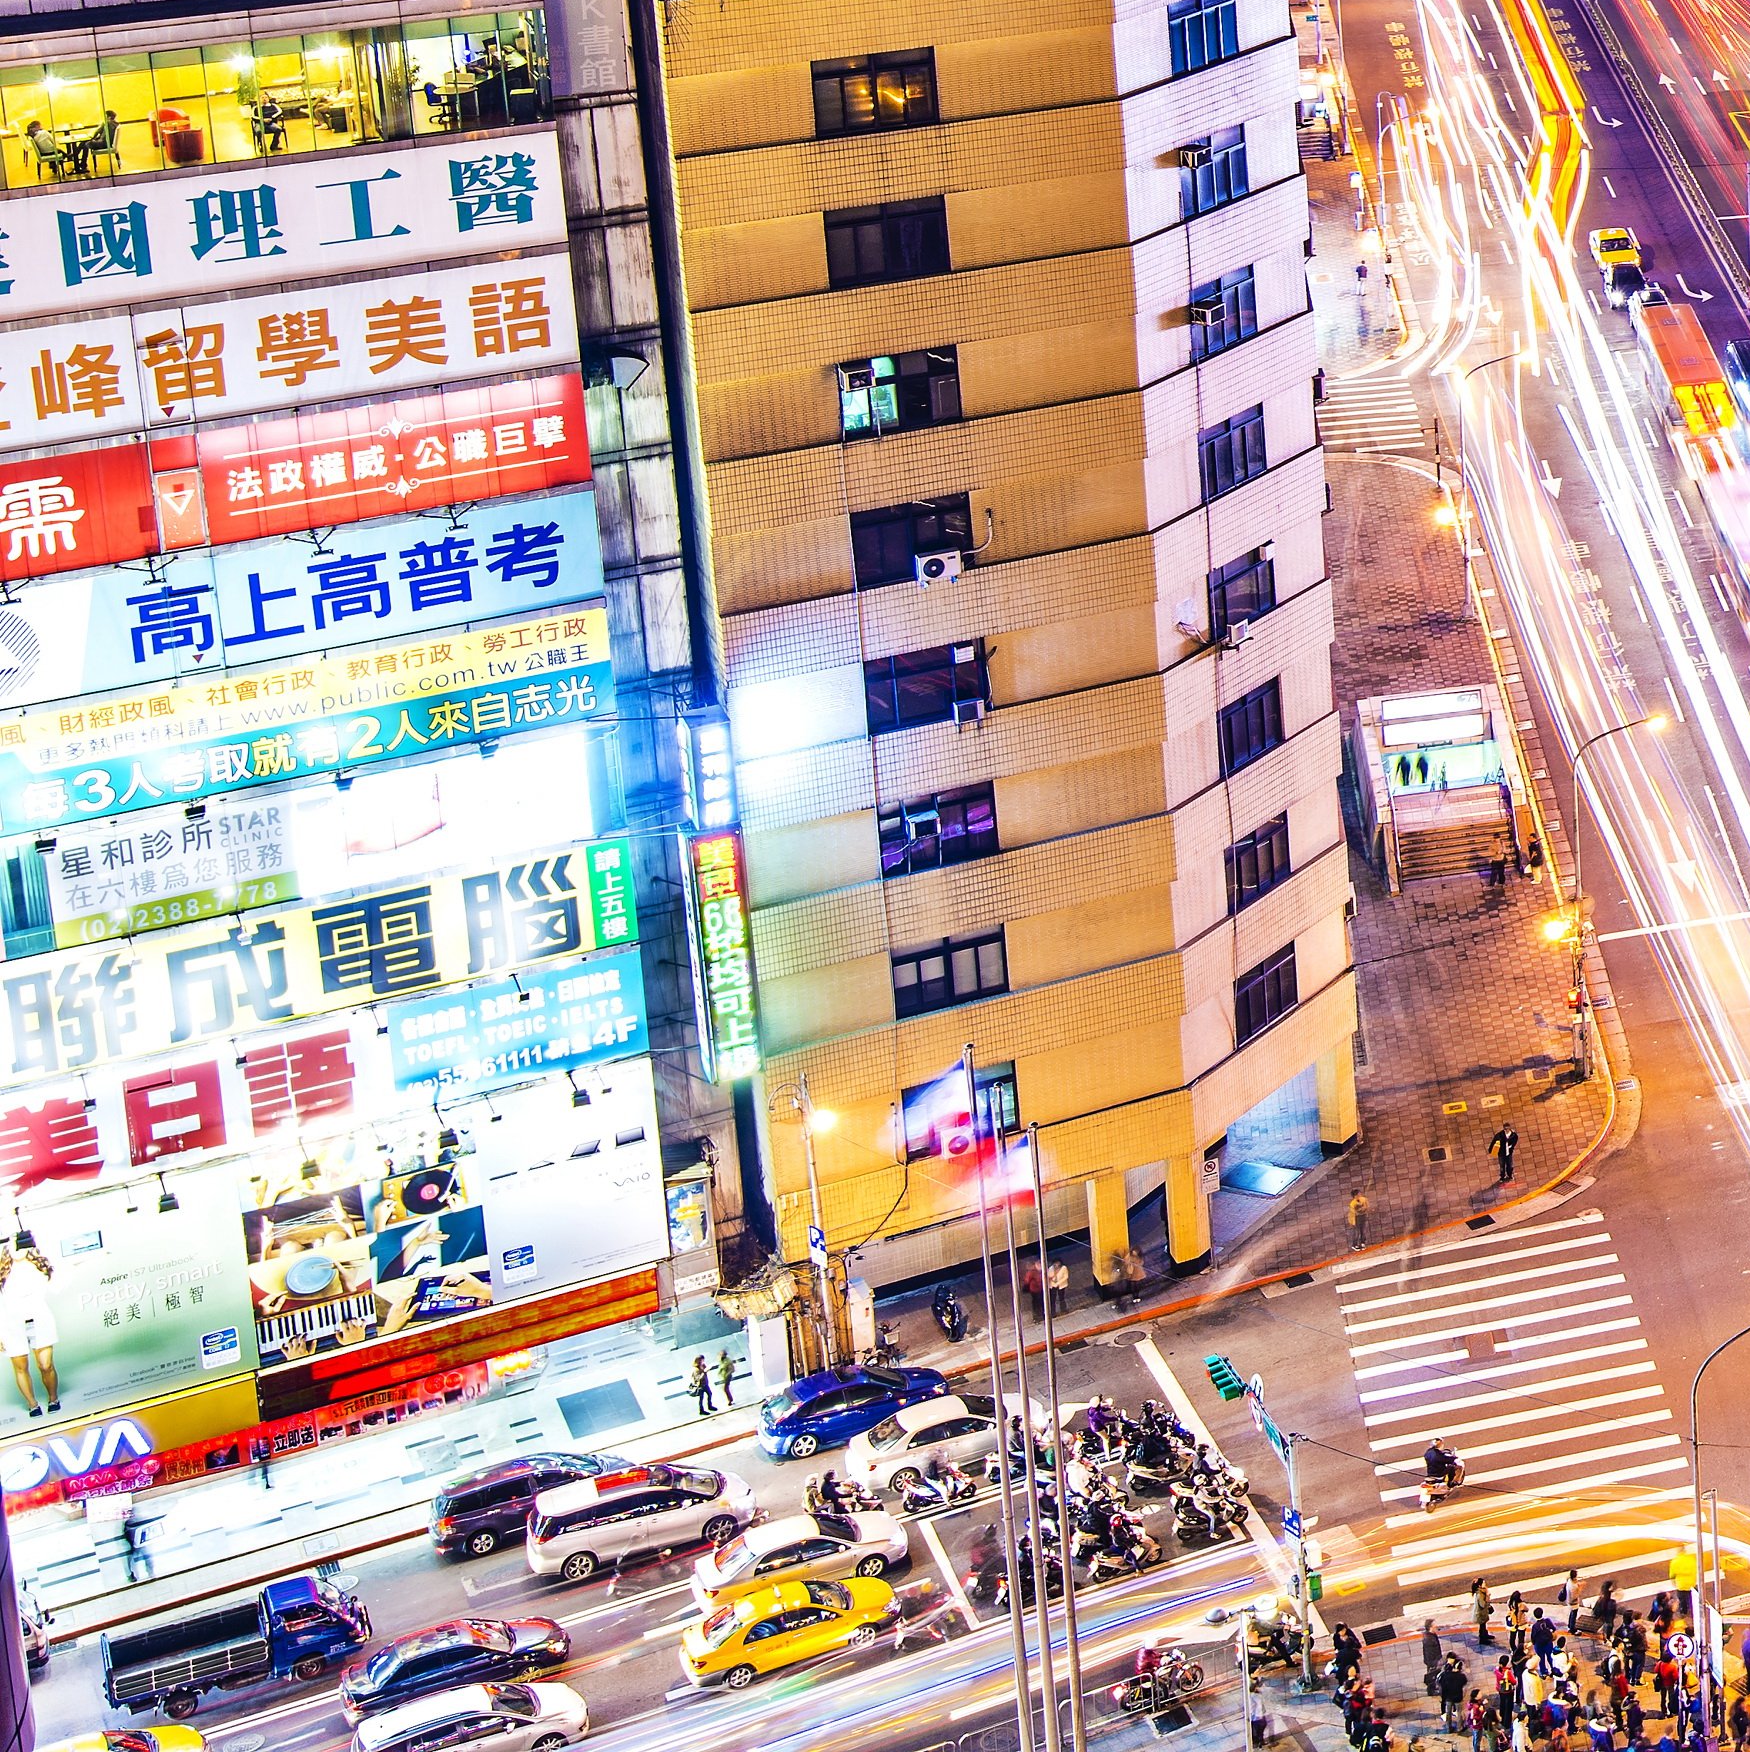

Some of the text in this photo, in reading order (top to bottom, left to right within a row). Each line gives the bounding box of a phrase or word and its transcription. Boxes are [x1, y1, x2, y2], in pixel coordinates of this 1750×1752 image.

[0, 151, 540, 291] 國理工醫
[126, 520, 565, 664] 高上高普考
[241, 660, 518, 726] www.public.com.tw
[524, 643, 590, 671] 公職王
[219, 806, 282, 835] STAR
[220, 826, 284, 848] CLINIC
[60, 819, 213, 880] 星和診所
[593, 848, 629, 941] 請上五樓
[2, 854, 581, 1081] 聯成電腦
[483, 1015, 547, 1046] TOEIC
[561, 996, 624, 1024] IELTS
[592, 1015, 638, 1046] 4F
[0, 1028, 356, 1196] 美日語
[613, 1171, 651, 1187] VAIO
[81, 1259, 223, 1311] Pretty, smart
[101, 1272, 129, 1286] Aspire
[103, 1285, 205, 1328] 絕美 極智
